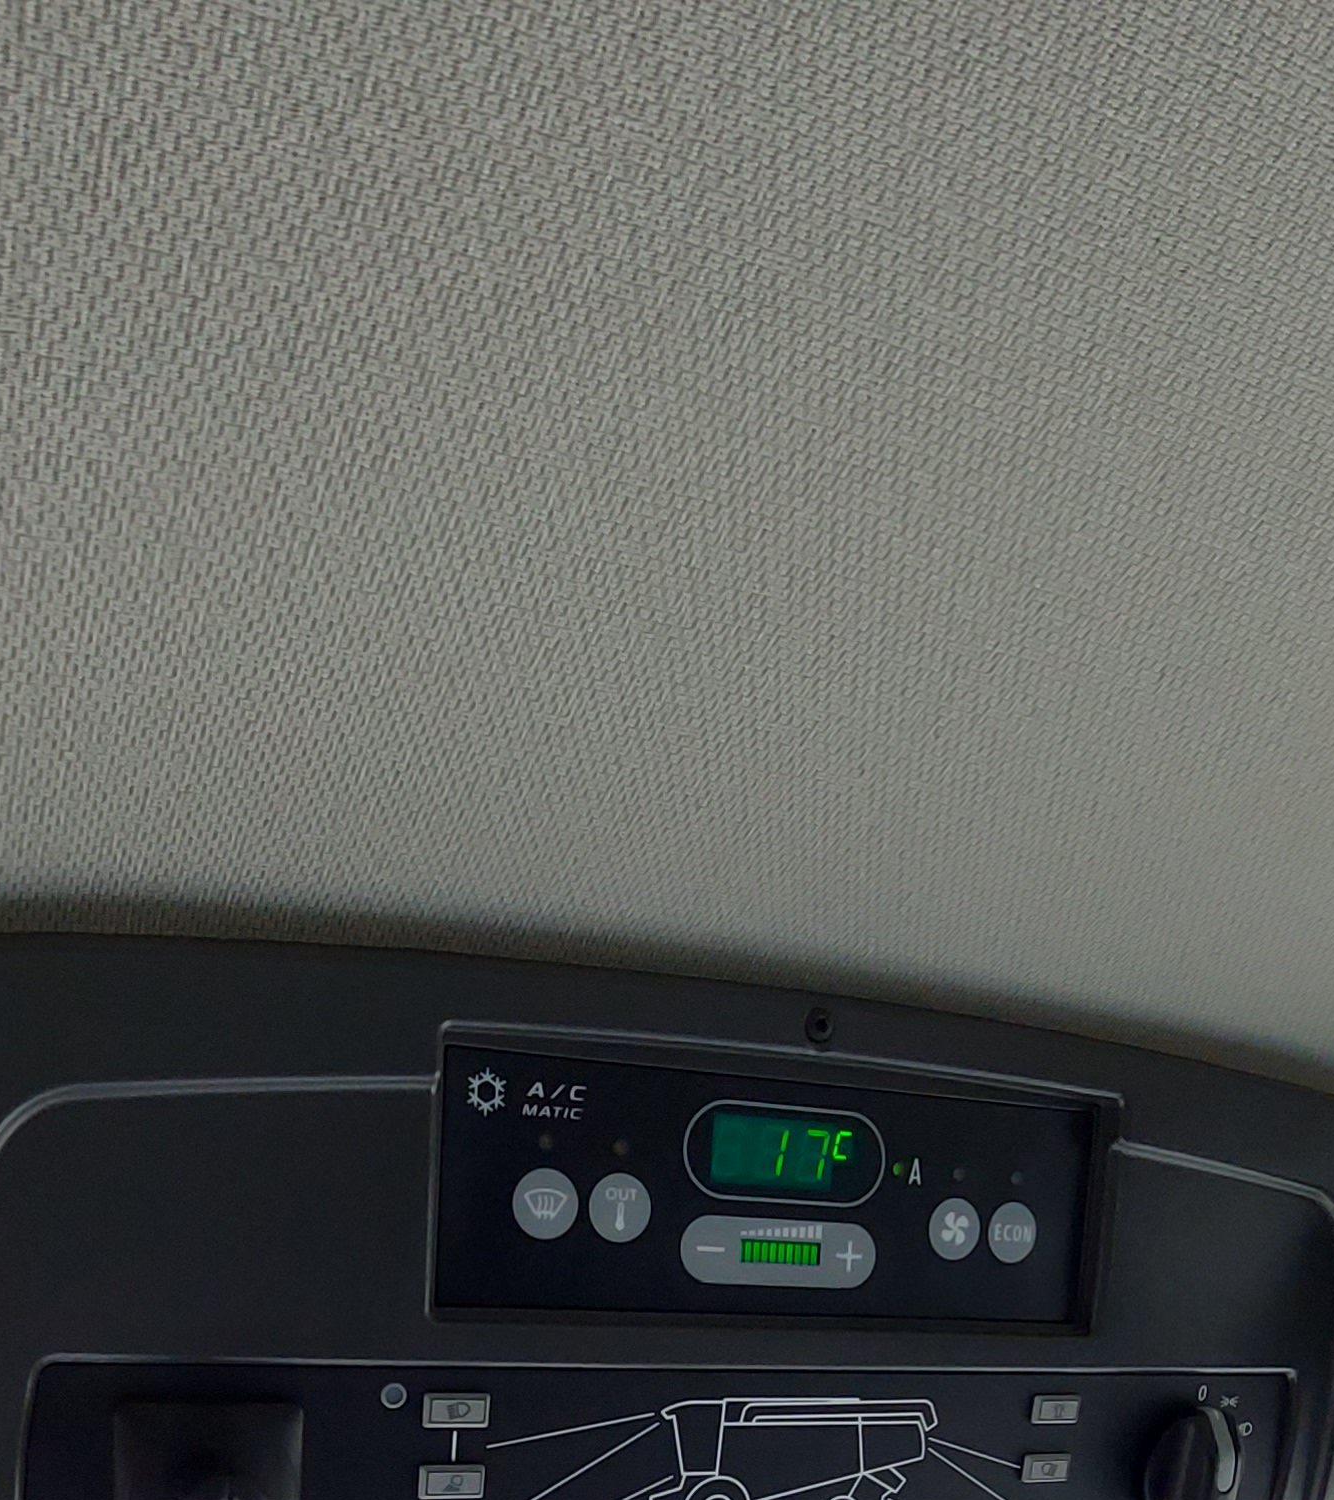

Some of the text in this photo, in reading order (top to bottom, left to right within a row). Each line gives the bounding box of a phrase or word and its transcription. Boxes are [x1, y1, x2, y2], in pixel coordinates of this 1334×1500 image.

[526, 1081, 588, 1102] A/C
[522, 1103, 584, 1121] MATIC
[907, 1157, 922, 1186] A
[605, 1186, 638, 1201] OUT
[993, 1221, 1033, 1243] ECON
